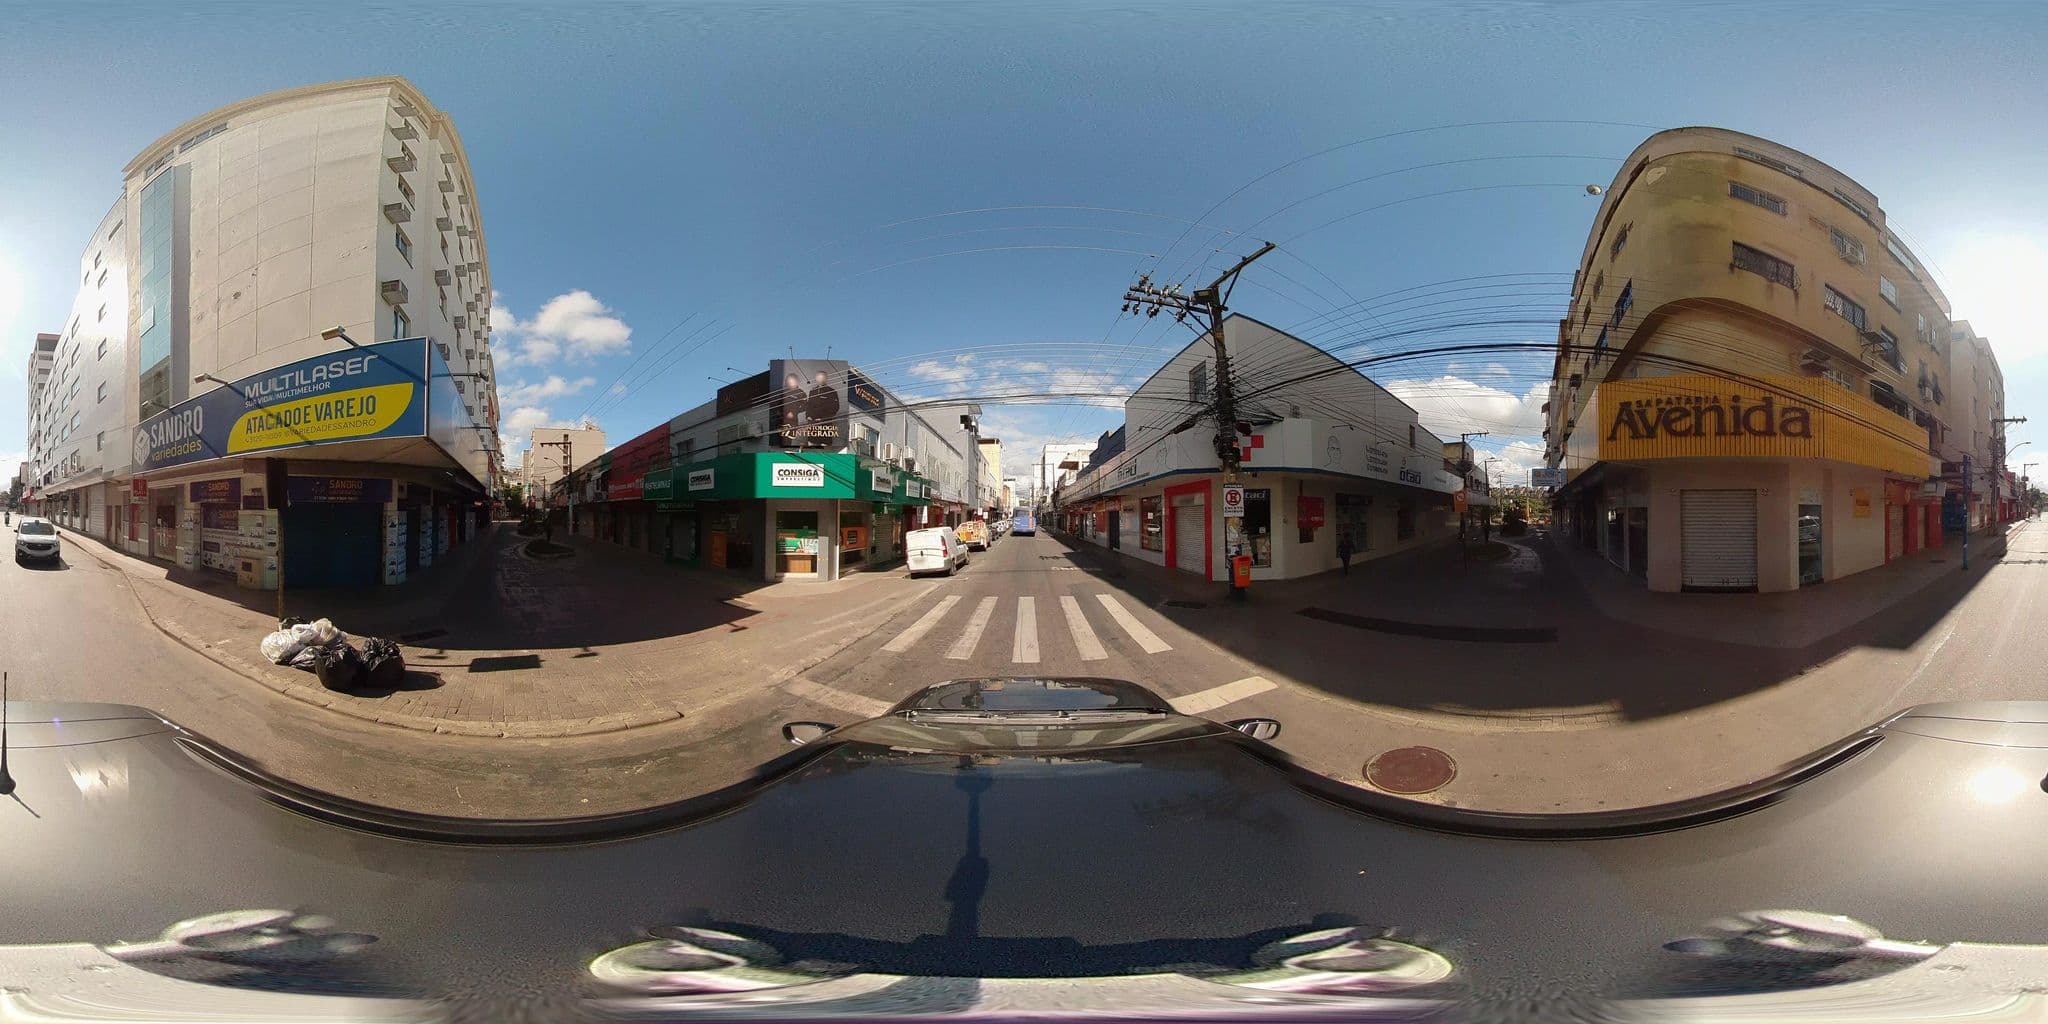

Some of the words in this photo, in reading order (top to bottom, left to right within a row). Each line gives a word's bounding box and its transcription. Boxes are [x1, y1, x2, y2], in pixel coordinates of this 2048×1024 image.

[275, 381, 331, 399] MULTIMELHOR
[1635, 395, 1719, 408] SAPATARIA
[246, 407, 301, 435] ATACADO
[303, 405, 312, 424] E
[315, 395, 377, 422] VAREJO
[1607, 394, 1812, 441] Avenida
[150, 405, 203, 449] SANDRO
[151, 440, 202, 462] variedades
[777, 468, 819, 477] CONSIGA
